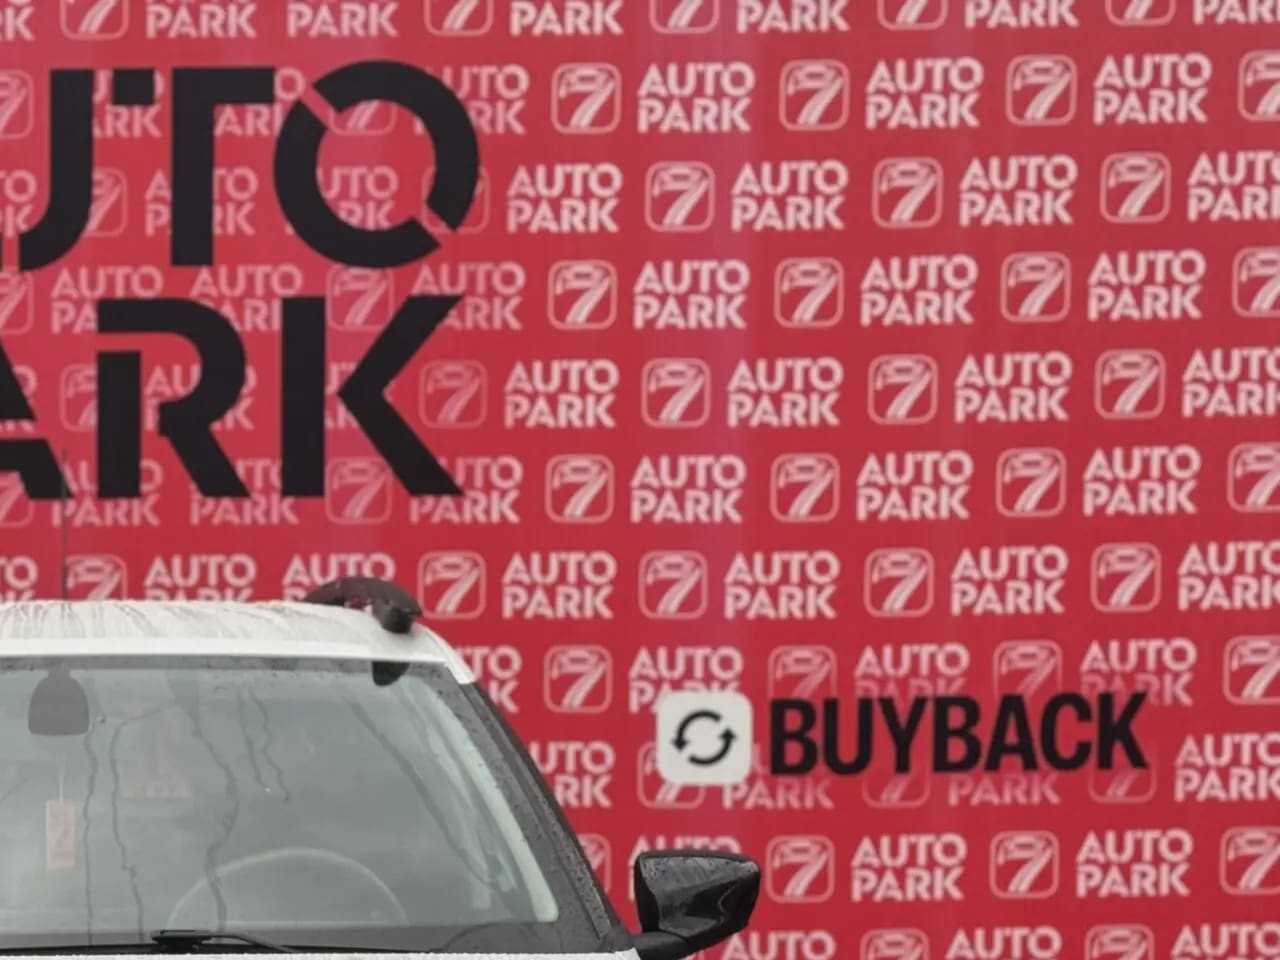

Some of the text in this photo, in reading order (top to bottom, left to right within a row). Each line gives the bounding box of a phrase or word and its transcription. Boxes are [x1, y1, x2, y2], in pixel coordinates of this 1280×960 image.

[145, 3, 257, 39] PARK
[286, 2, 398, 38] PARK
[510, 0, 622, 36] PARK
[736, 0, 848, 33] PARK
[638, 62, 753, 98] AUTO
[867, 58, 982, 94] AUTO
[1095, 53, 1210, 89] AUTO
[638, 96, 750, 132] PARK
[867, 92, 979, 128] PARK
[1095, 87, 1207, 123] PARK
[507, 163, 622, 199] AUTO
[732, 161, 847, 197] AUTO
[961, 155, 1076, 191] AUTO
[507, 197, 619, 233] PARK
[732, 195, 844, 231] PARK
[961, 189, 1073, 225] PARK
[50, 265, 165, 301] AUTO
[189, 263, 304, 299] AUTO
[411, 261, 526, 297] AUTO
[634, 259, 749, 295] AUTO
[861, 255, 976, 291] AUTO
[1089, 250, 1204, 286] AUTO
[634, 293, 746, 329] PARK
[861, 289, 973, 325] PARK
[1089, 284, 1201, 320] PARK
[504, 359, 619, 395] AUTO
[728, 357, 843, 393] AUTO
[955, 352, 1070, 388] AUTO
[504, 393, 616, 429] PARK
[728, 391, 840, 427] PARK
[955, 386, 1067, 422] PARK
[631, 454, 746, 490] AUTO
[857, 451, 972, 487] AUTO
[1084, 445, 1199, 481] AUTO
[50, 493, 162, 529] PARK
[188, 491, 300, 527] PARK
[408, 489, 520, 525] PARK
[631, 488, 743, 524] PARK
[857, 485, 969, 521] PARK
[1084, 479, 1196, 515] PARK
[144, 554, 257, 590] AUTO
[501, 550, 616, 586] AUTO
[724, 550, 839, 586] AUTO
[952, 545, 1067, 581] AUTO
[501, 584, 613, 620] PARK
[724, 584, 836, 620] PARK
[952, 579, 1064, 615] PARK
[629, 645, 744, 681] AUTO
[854, 642, 969, 678] AUTO
[1081, 637, 1196, 673] AUTO
[769, 690, 1148, 777] BUYBACK
[851, 832, 966, 868] AUTO
[1077, 828, 1192, 864] AUTO
[851, 866, 963, 902] PARK
[1077, 862, 1189, 898] PARK
[946, 925, 1061, 960] AUTO
[1172, 922, 1280, 958] AUTO
